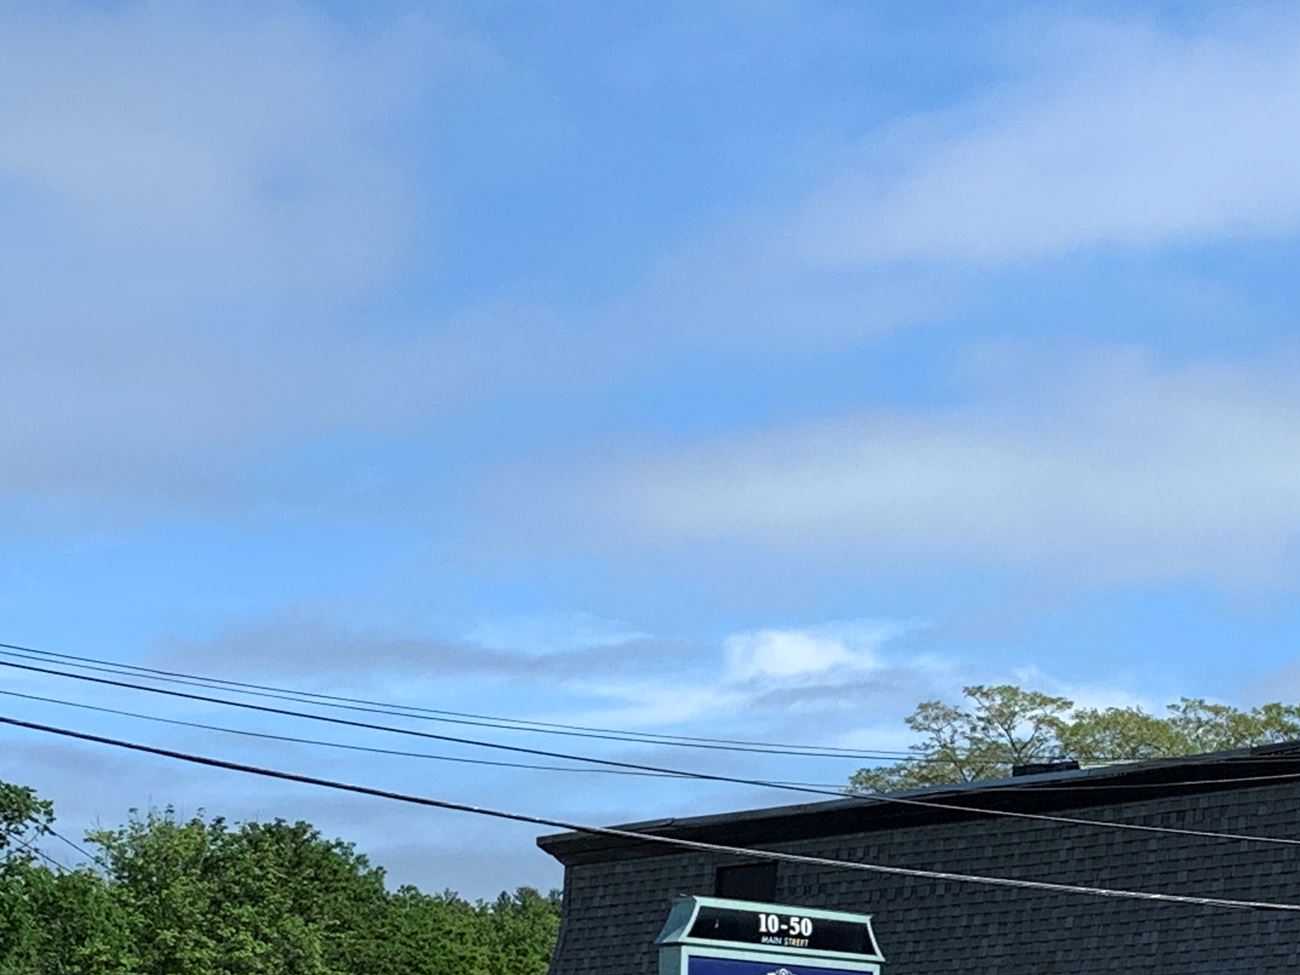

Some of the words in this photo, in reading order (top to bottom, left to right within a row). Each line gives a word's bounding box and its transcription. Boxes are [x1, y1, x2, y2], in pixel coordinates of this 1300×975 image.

[758, 914, 813, 936] 10-50
[761, 936, 782, 945] MAIN
[784, 937, 809, 947] STREET
